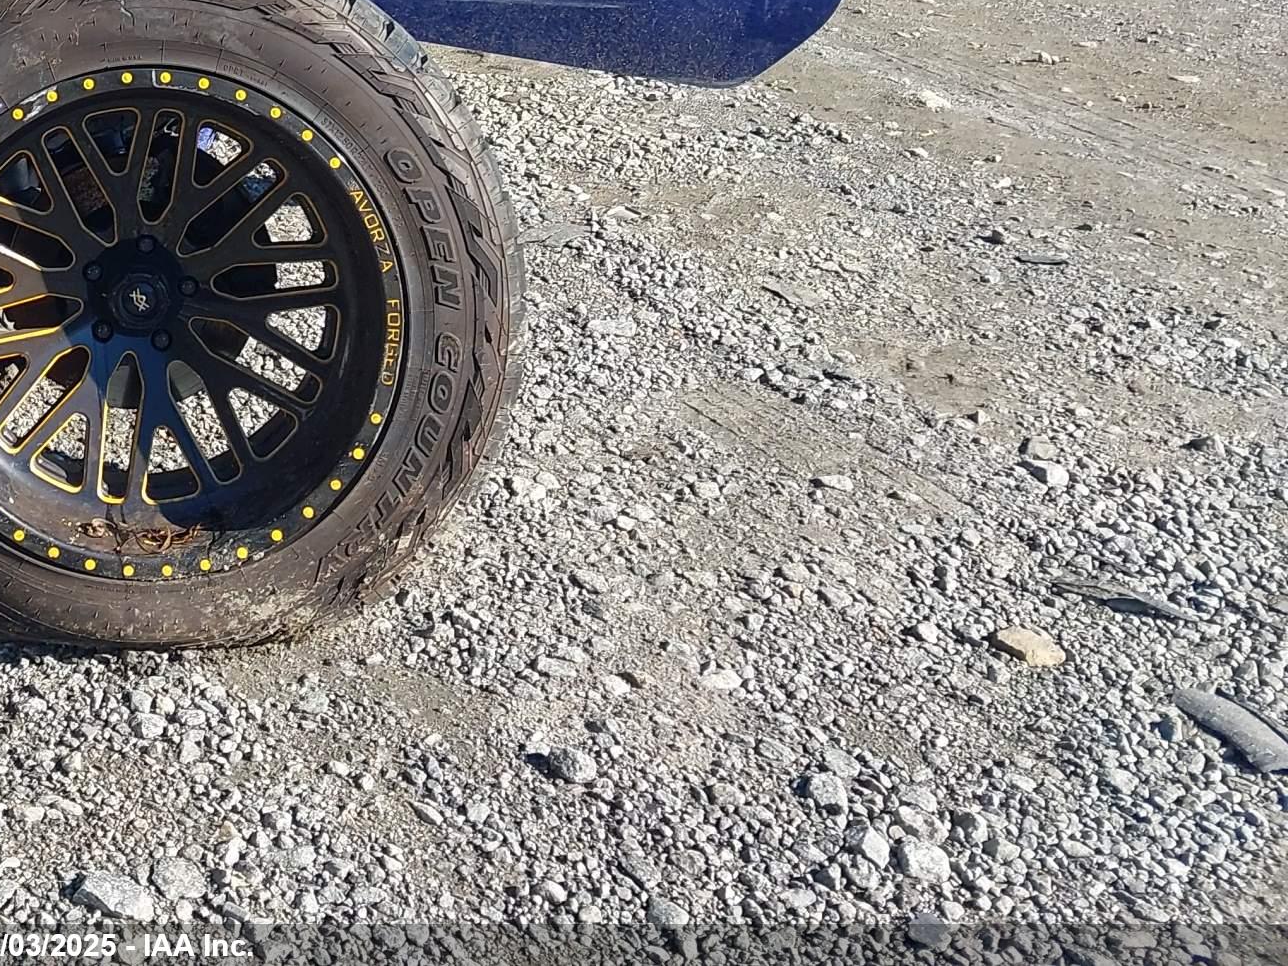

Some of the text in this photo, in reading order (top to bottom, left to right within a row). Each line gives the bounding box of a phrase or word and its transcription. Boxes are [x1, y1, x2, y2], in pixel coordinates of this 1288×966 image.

[349, 189, 395, 274] AVORZA
[381, 298, 402, 386] FORGED
[383, 146, 463, 311] OPEN
